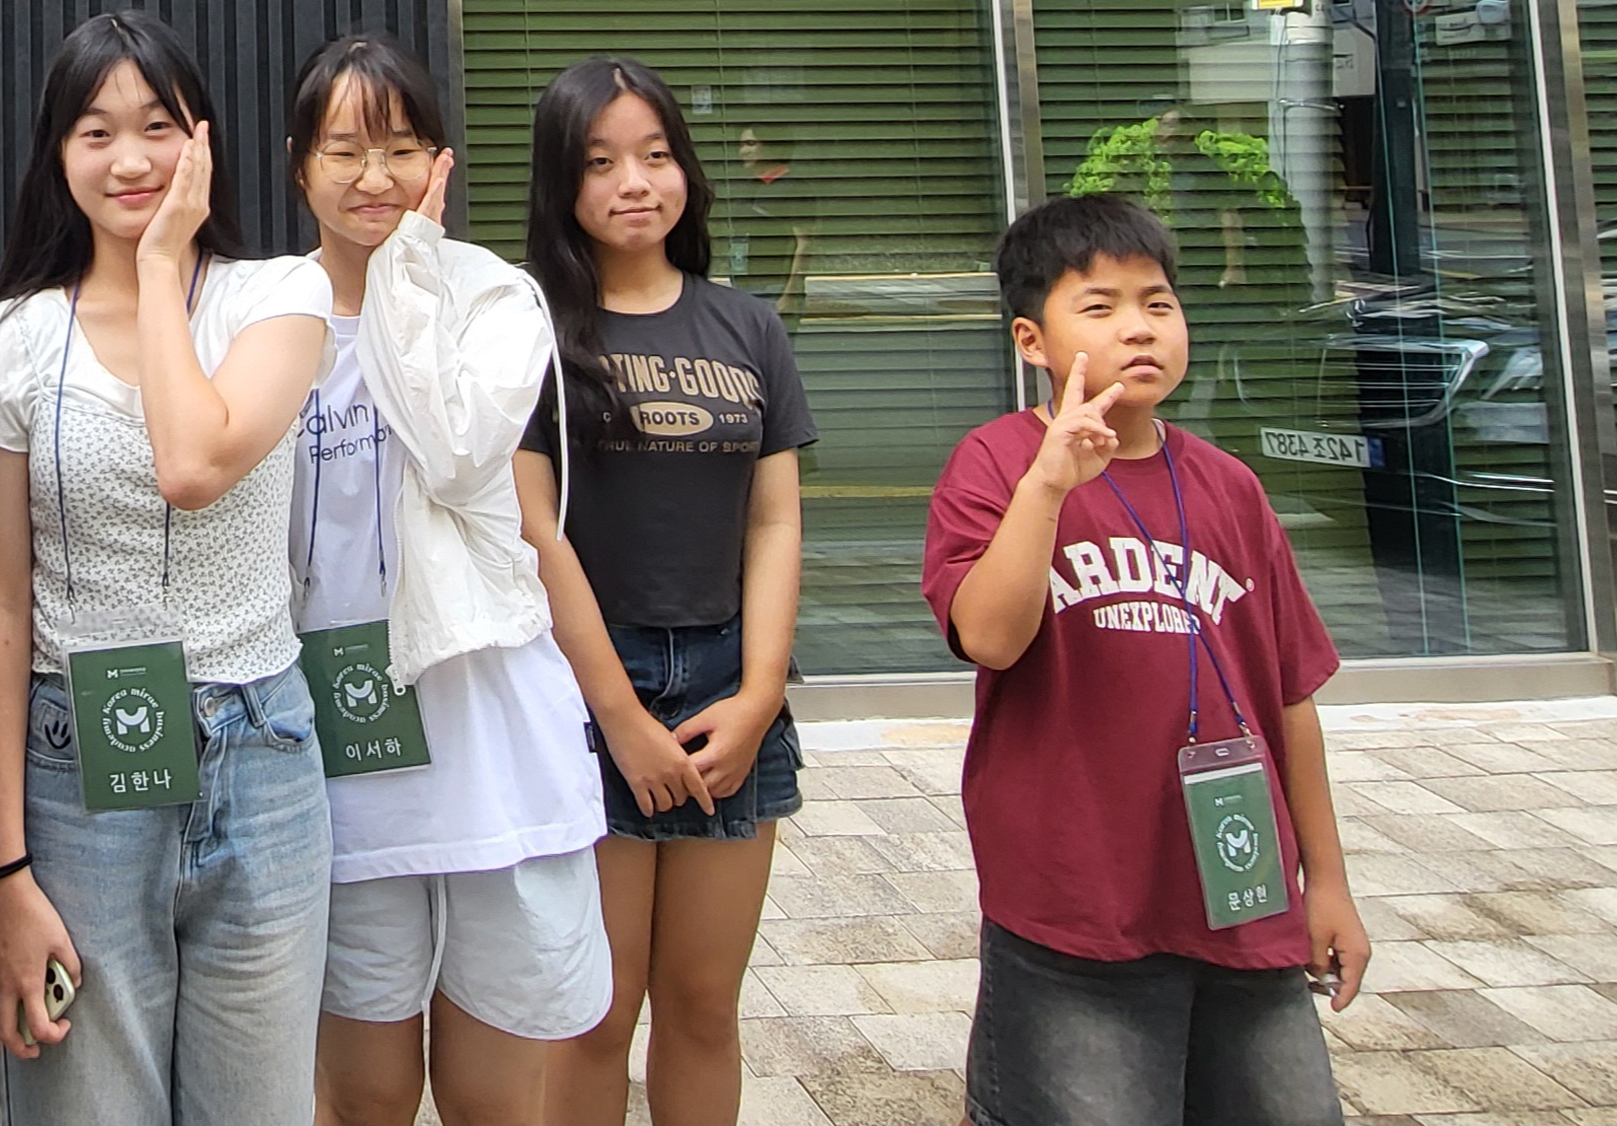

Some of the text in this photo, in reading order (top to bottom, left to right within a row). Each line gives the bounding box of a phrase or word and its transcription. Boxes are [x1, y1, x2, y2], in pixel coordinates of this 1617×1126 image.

[640, 411, 749, 426] ROOTS 1973
[698, 441, 718, 453] OF
[344, 737, 403, 762] 이서하
[108, 769, 173, 794] 김한나
